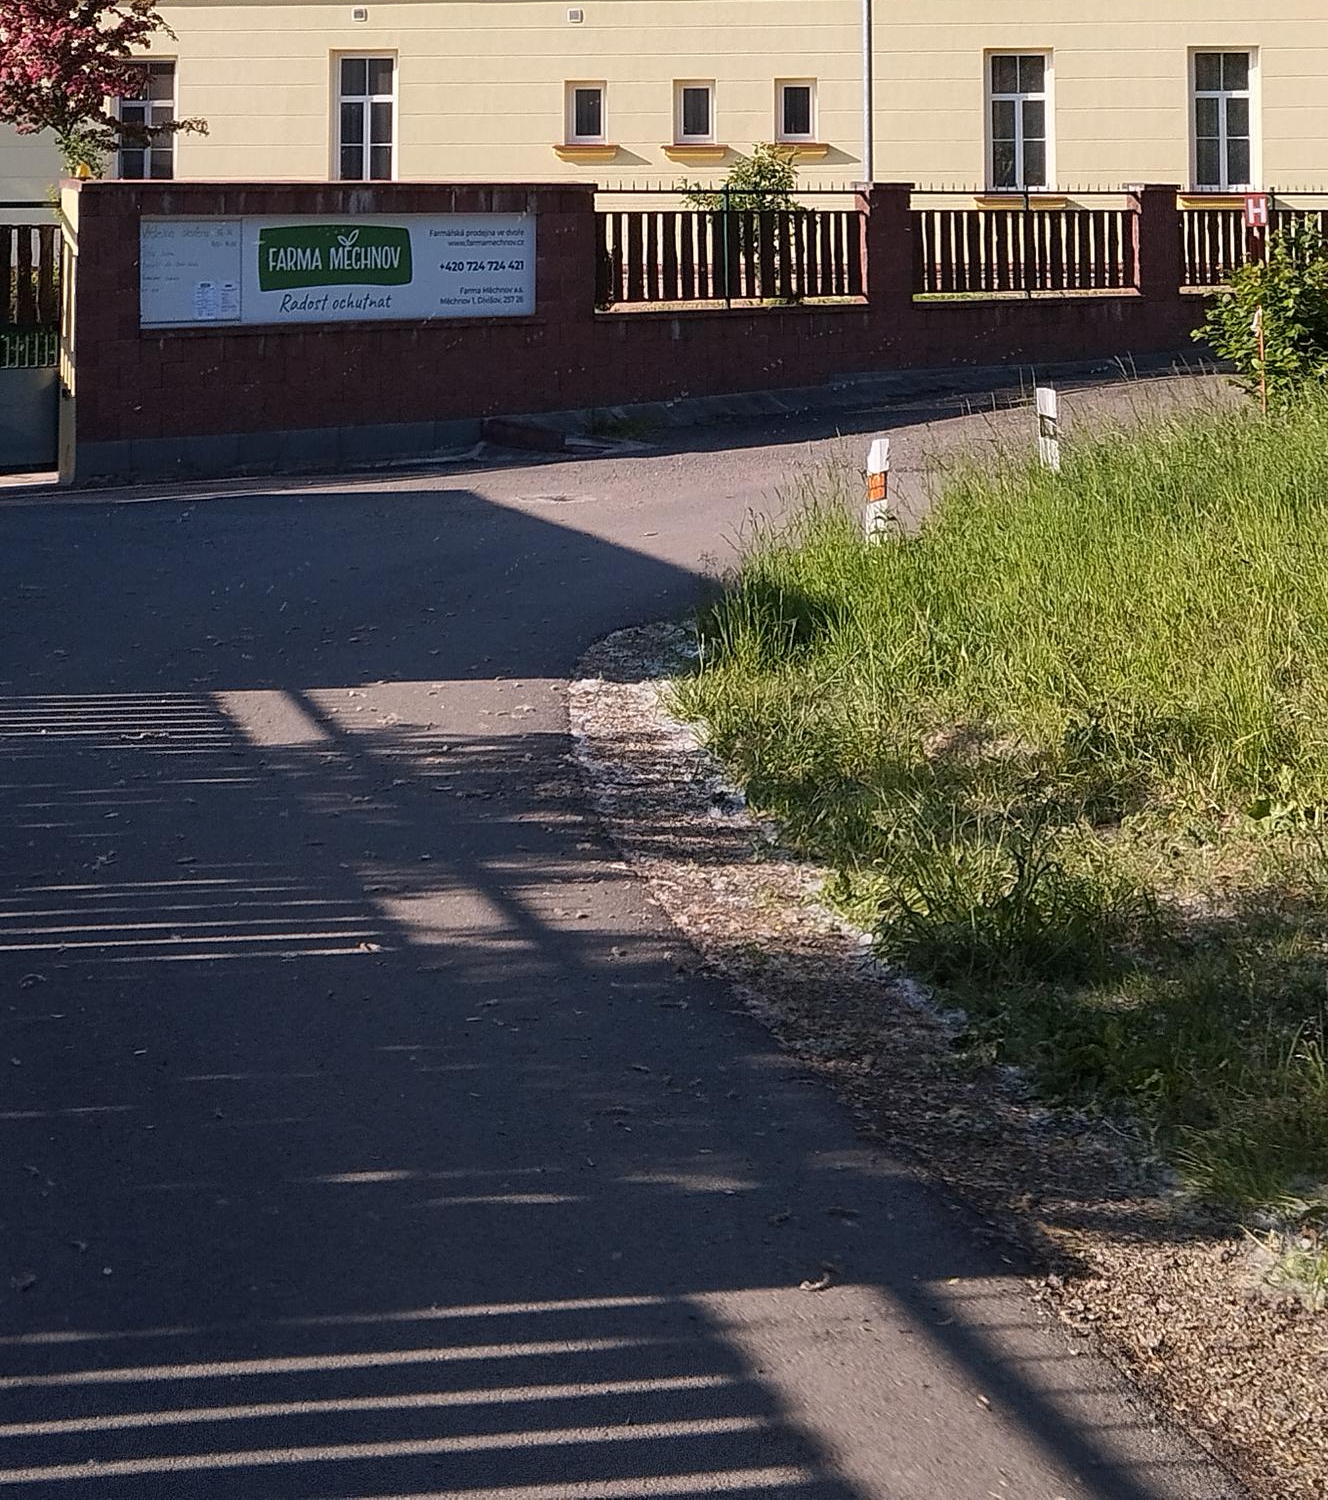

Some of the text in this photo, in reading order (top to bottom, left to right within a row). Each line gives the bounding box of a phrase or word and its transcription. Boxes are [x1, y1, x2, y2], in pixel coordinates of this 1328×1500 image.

[1247, 198, 1267, 224] H
[466, 229, 495, 238] prodejna
[268, 247, 322, 272] FARMA
[440, 260, 524, 271] +420 724 724 421
[460, 286, 481, 294] Farma
[279, 293, 392, 313] Radost ochutnat
